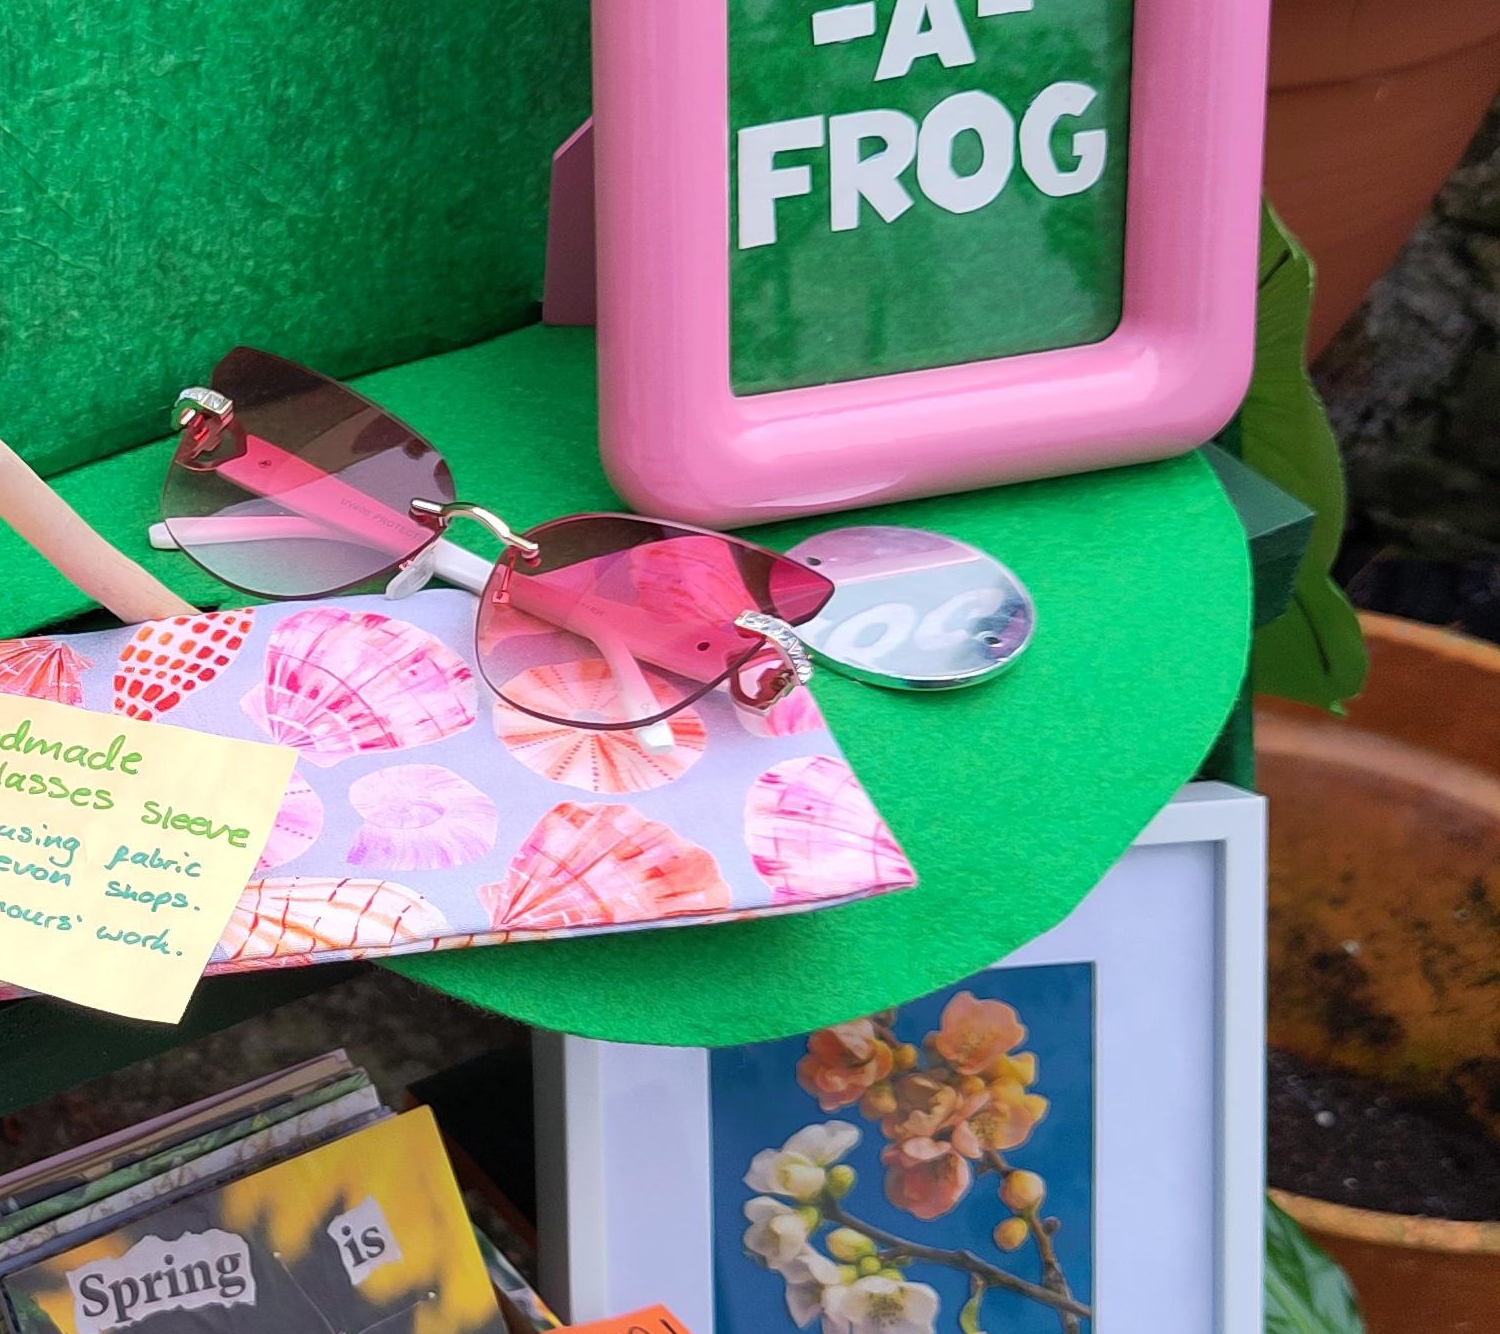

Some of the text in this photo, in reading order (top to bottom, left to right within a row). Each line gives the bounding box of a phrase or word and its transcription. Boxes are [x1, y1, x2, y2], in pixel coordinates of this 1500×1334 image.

[738, 82, 1107, 249] FROG
[105, 845, 202, 877] fabric
[105, 880, 201, 912] shops.
[96, 925, 183, 956] work.
[78, 1224, 386, 1323] Spring is
